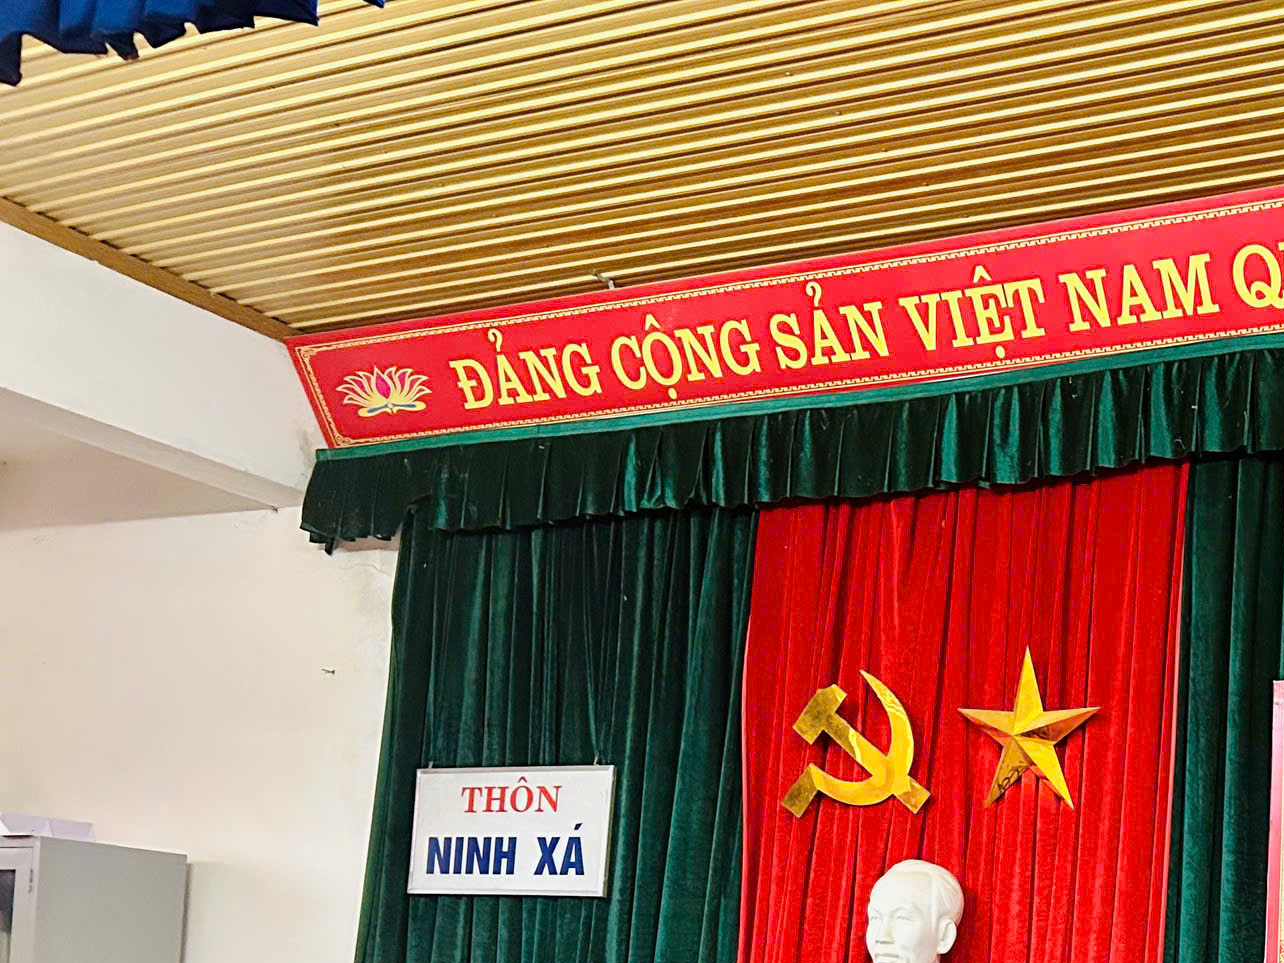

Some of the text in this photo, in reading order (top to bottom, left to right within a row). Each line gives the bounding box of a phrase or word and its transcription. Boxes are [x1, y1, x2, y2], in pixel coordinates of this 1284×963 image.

[449, 327, 602, 410] ĐẢNG
[610, 313, 761, 400] CỘNG
[770, 282, 888, 369] SẢN
[899, 266, 1046, 360] VIỆT
[1059, 252, 1221, 332] NAM
[461, 776, 562, 813] THÔN
[426, 822, 585, 876] NINH XÁ
